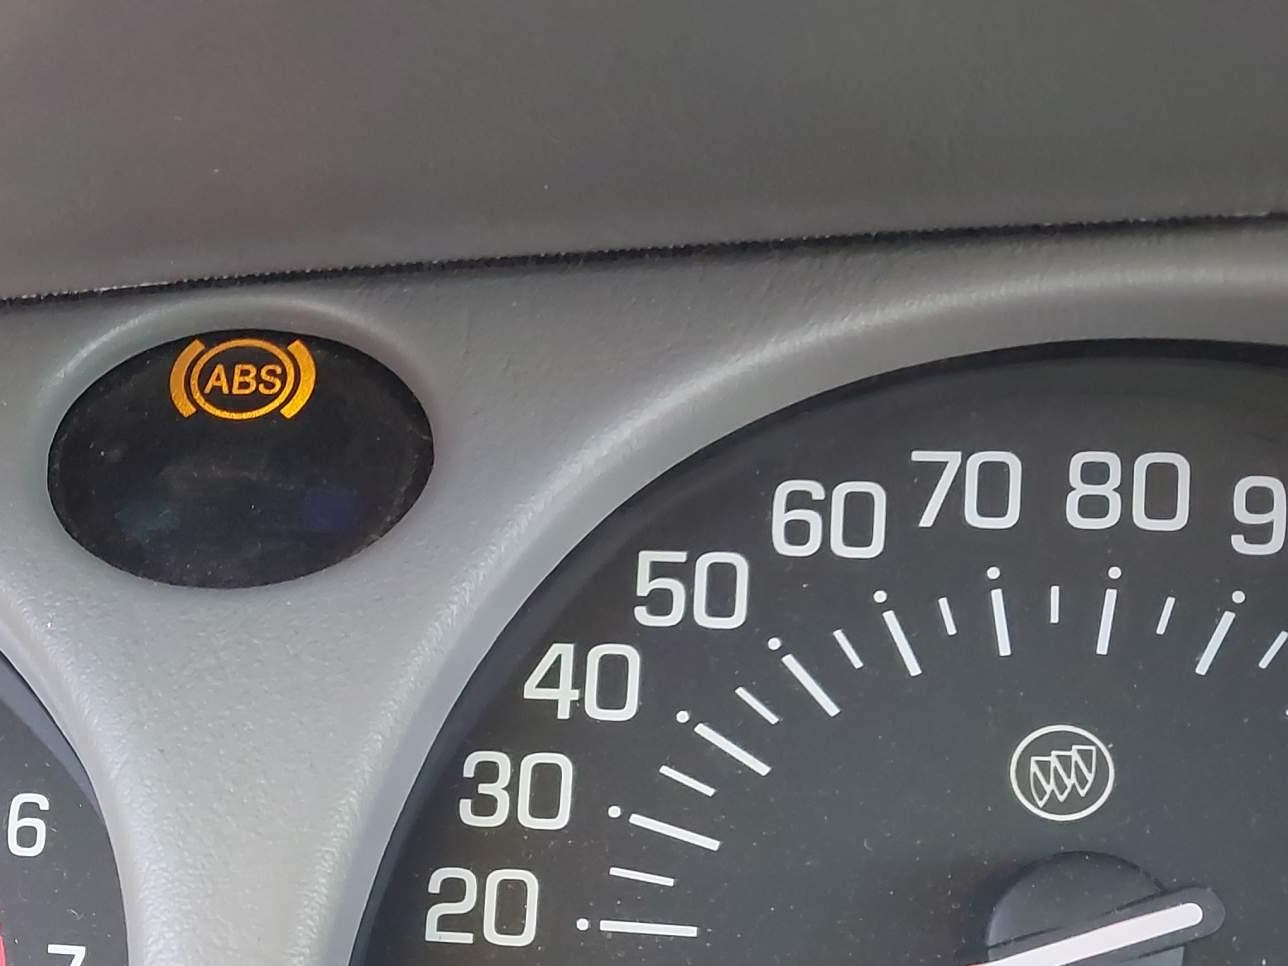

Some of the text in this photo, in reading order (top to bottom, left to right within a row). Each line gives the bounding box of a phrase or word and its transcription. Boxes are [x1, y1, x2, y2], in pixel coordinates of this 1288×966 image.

[203, 362, 284, 396] ABS
[771, 479, 887, 559] 60
[910, 450, 1022, 530] 70
[1065, 451, 1191, 532] 80
[634, 550, 749, 630] 50
[523, 643, 641, 722] 40
[7, 792, 50, 857] 6
[459, 750, 574, 830] 30
[425, 867, 540, 947] 20
